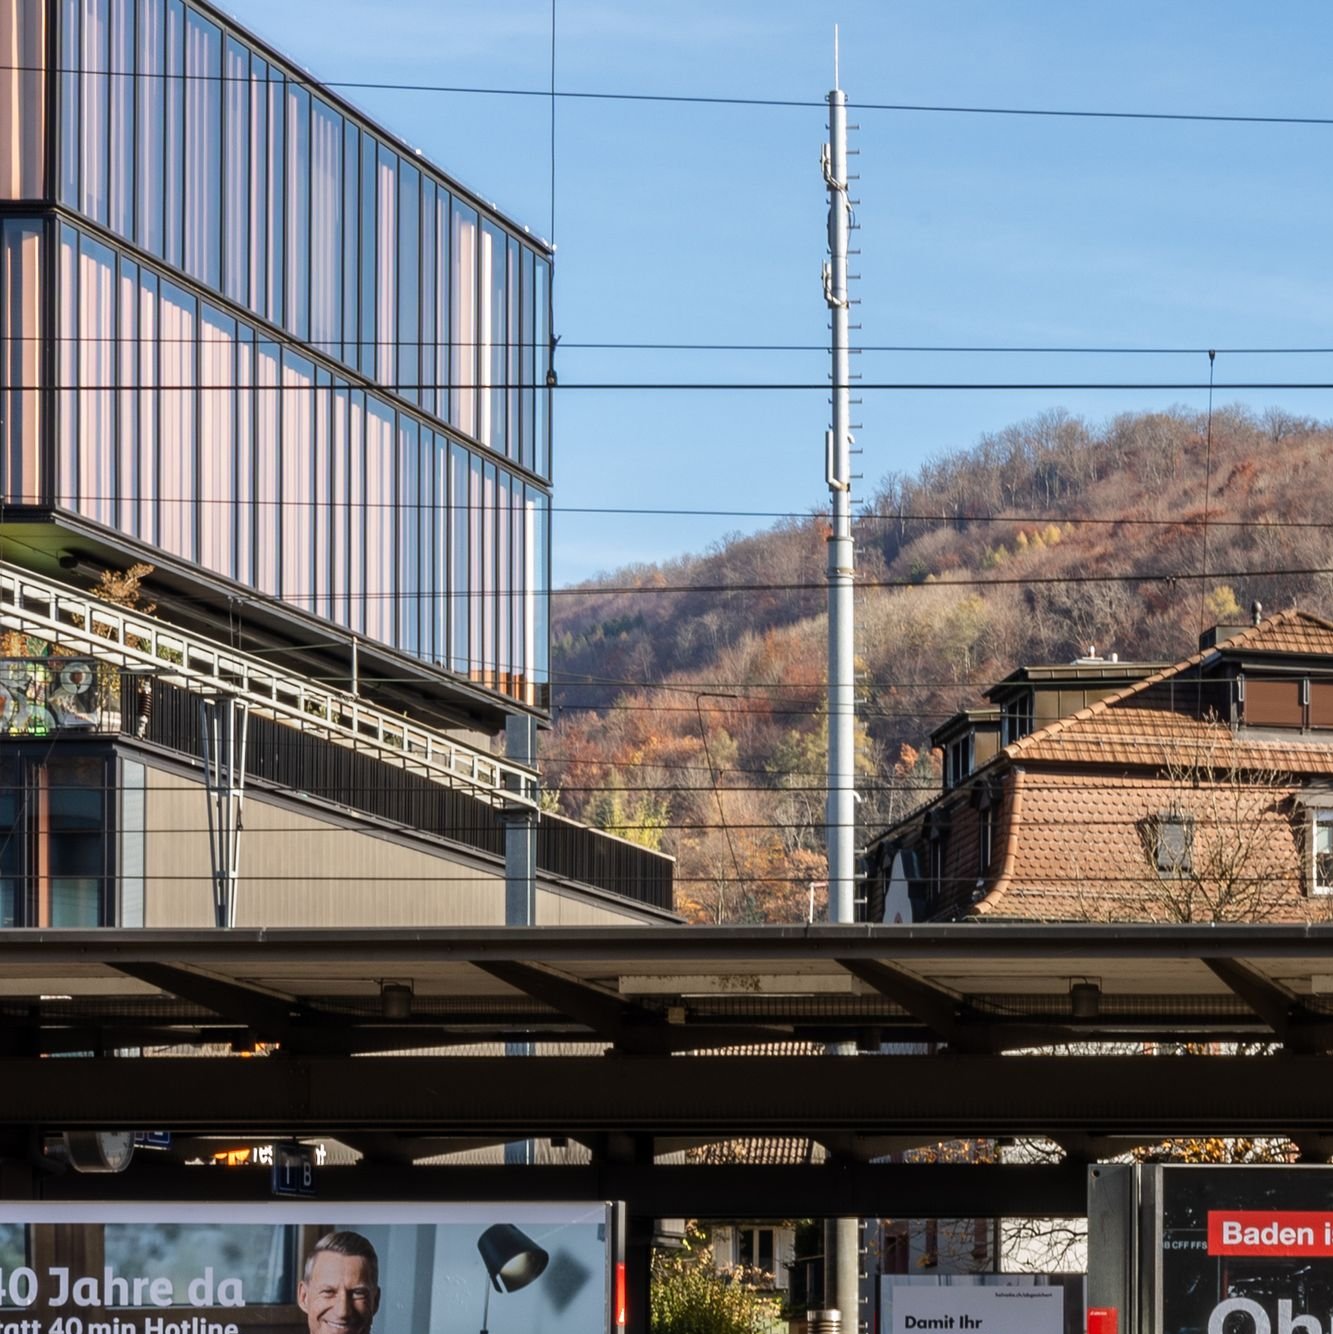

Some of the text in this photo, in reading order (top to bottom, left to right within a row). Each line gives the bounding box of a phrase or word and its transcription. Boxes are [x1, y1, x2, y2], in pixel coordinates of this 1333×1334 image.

[1222, 1221, 1314, 1246] Baden
[1172, 1240, 1189, 1249] CFF
[48, 1266, 174, 1307] Jahre
[187, 1266, 246, 1307] da
[904, 1314, 983, 1329] Damit Ihr
